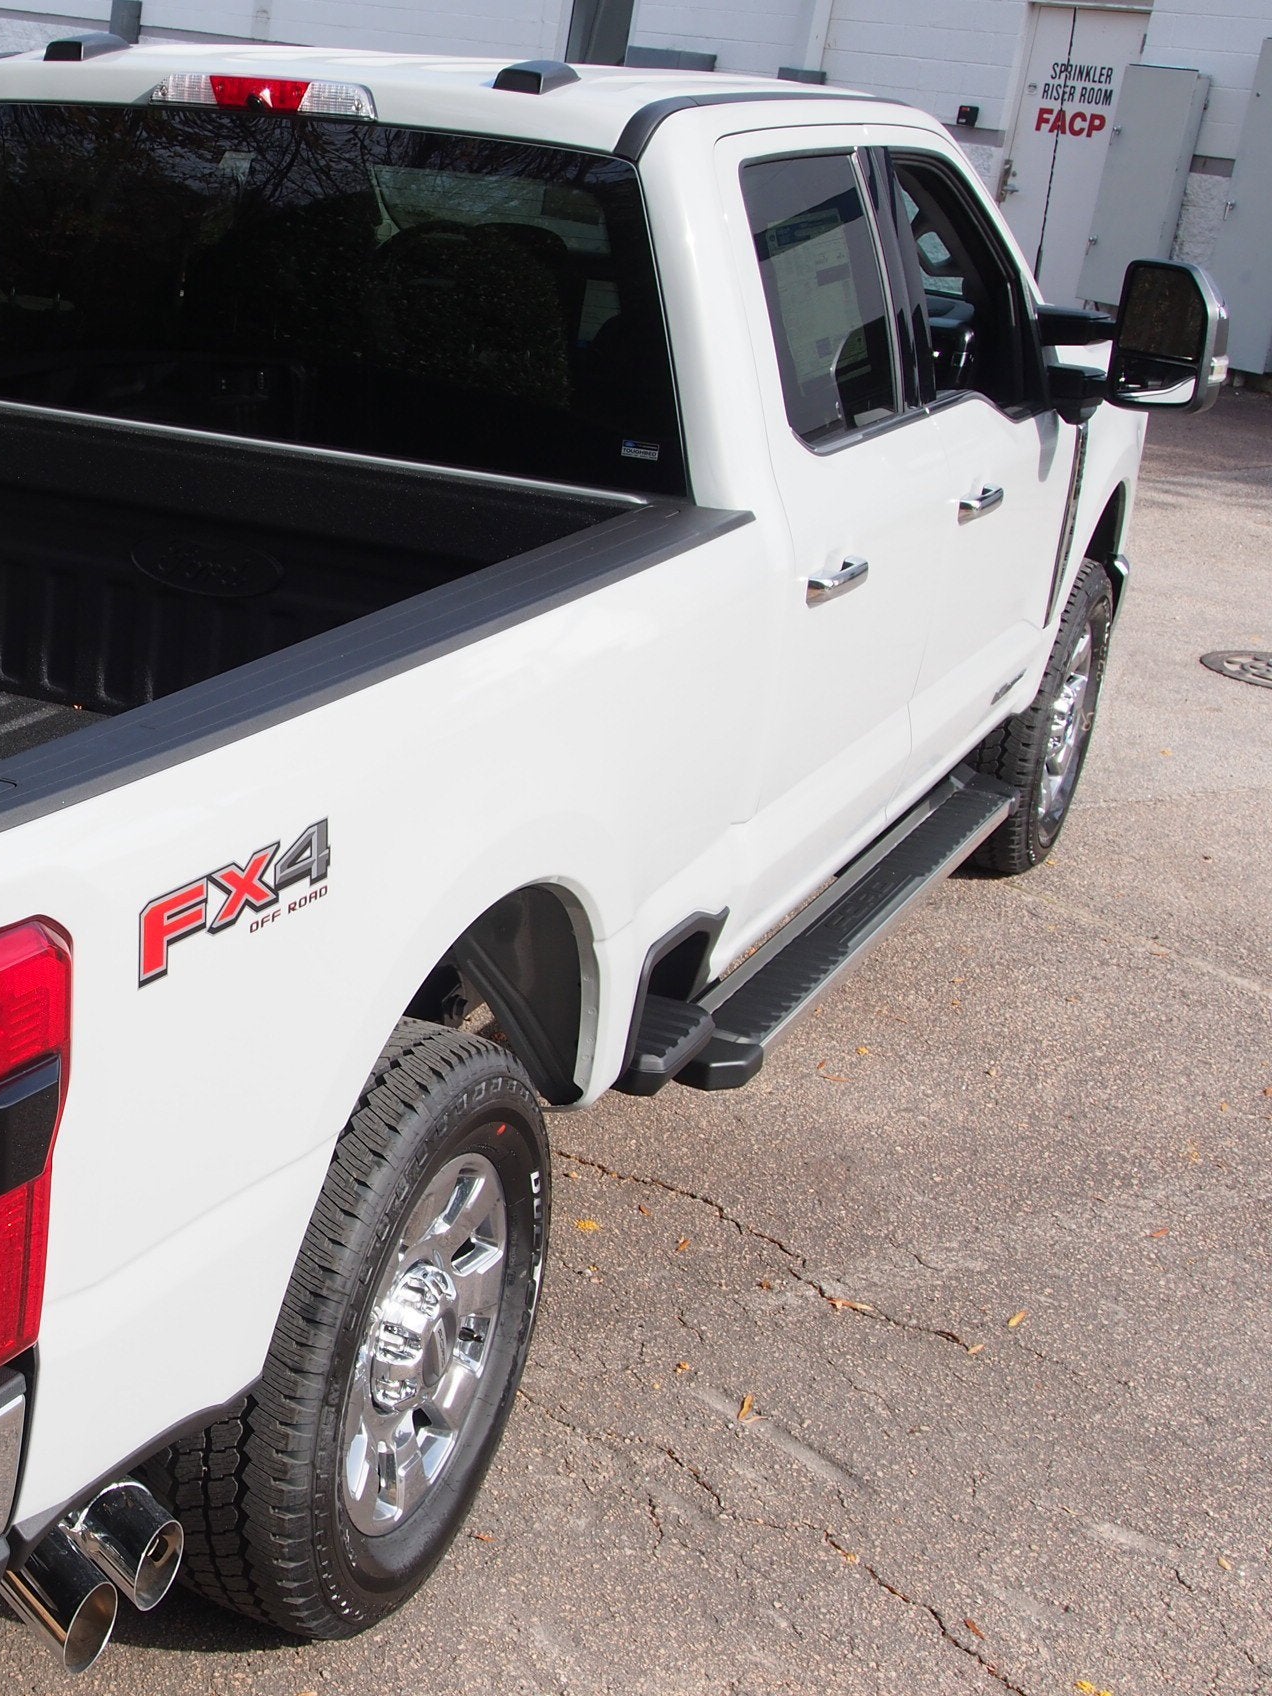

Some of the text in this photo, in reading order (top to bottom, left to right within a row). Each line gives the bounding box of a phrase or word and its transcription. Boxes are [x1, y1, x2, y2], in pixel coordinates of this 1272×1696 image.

[1050, 62, 1114, 85] SPRINKLER
[1041, 83, 1114, 107] RISER ROOM
[1035, 107, 1107, 138] FACP
[138, 816, 331, 990] FX4
[249, 884, 328, 934] OFF ROAD
